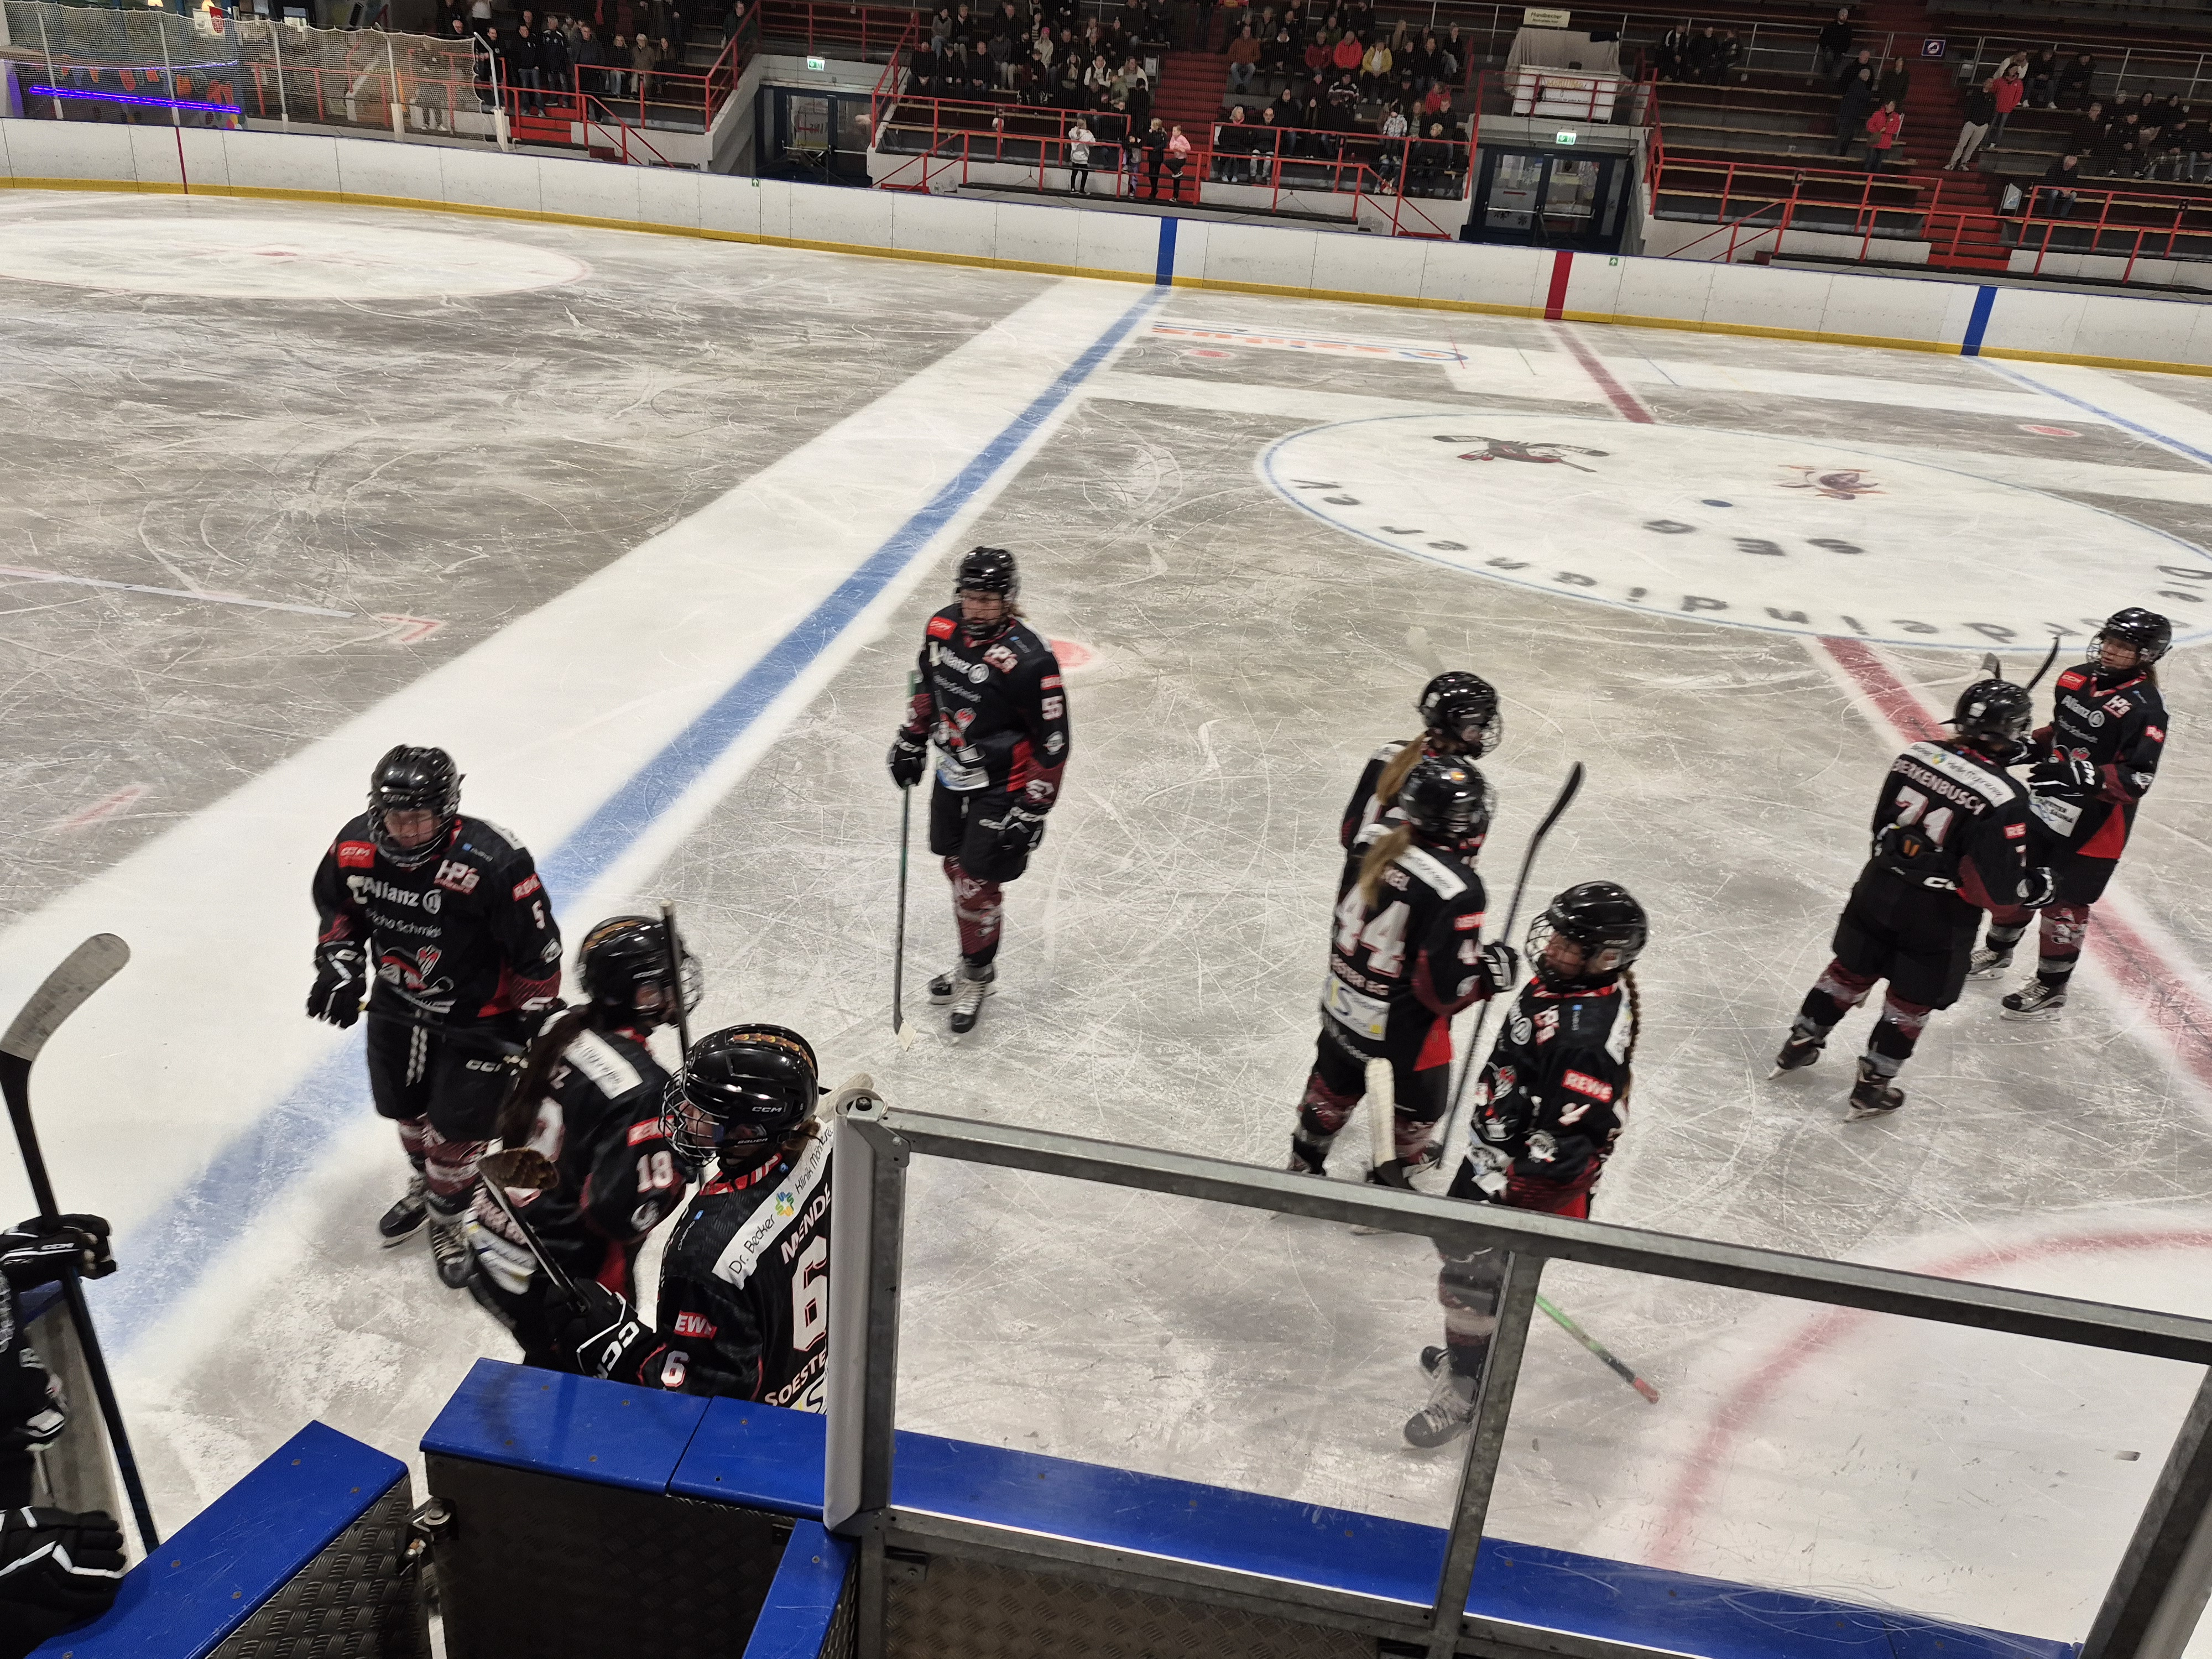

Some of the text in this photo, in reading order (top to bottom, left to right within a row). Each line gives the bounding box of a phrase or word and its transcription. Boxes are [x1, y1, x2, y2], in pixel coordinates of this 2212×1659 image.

[1895, 785, 1954, 846] 71
[363, 875, 420, 907] Allianz
[636, 1150, 674, 1193] 18
[729, 1254, 750, 1275] Dr.
[744, 1213, 776, 1254] Becker
[795, 1167, 814, 1194] Klinik
[792, 1235, 828, 1352] 6
[660, 1350, 691, 1388] 6
[764, 1349, 828, 1407] SOESTE
